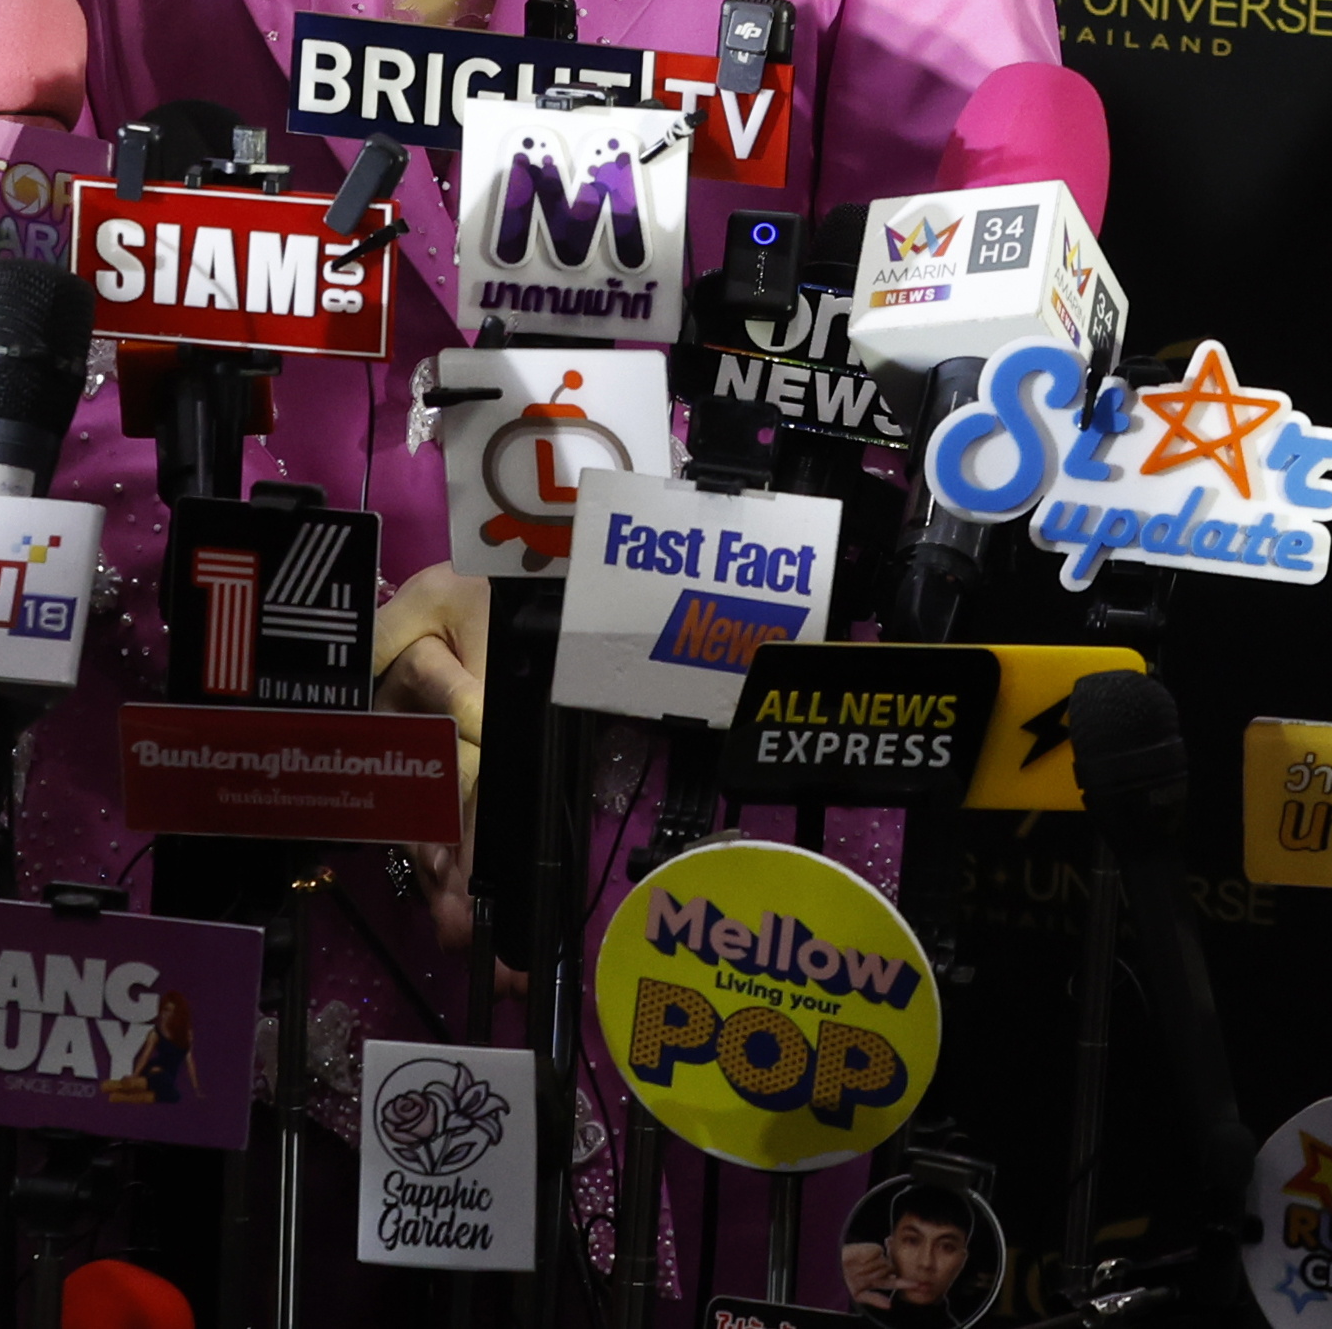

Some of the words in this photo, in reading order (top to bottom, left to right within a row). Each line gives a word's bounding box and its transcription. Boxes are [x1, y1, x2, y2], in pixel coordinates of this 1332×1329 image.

[665, 78, 776, 160] TV
[984, 215, 1025, 241] 34
[94, 217, 319, 318] SIAM
[872, 263, 957, 286] AMARIN
[978, 241, 1023, 265] HD
[885, 288, 936, 305] NEWS
[604, 512, 706, 580] Fast
[713, 529, 817, 596] Fact
[1040, 486, 1315, 581] update
[22, 598, 69, 633] 18
[755, 689, 828, 726] ALL
[838, 691, 958, 730] NEWS
[130, 739, 445, 780] Bunterngthaionline
[756, 730, 954, 769] EXPRESS
[644, 886, 922, 1009] Mellow
[715, 971, 785, 1006] Living
[790, 989, 842, 1017] your
[629, 976, 909, 1131] POP
[3, 1075, 55, 1093] SINCE
[58, 1079, 97, 1099] 2020
[383, 1170, 494, 1218] Sapphic
[377, 1204, 493, 1251] Garden
